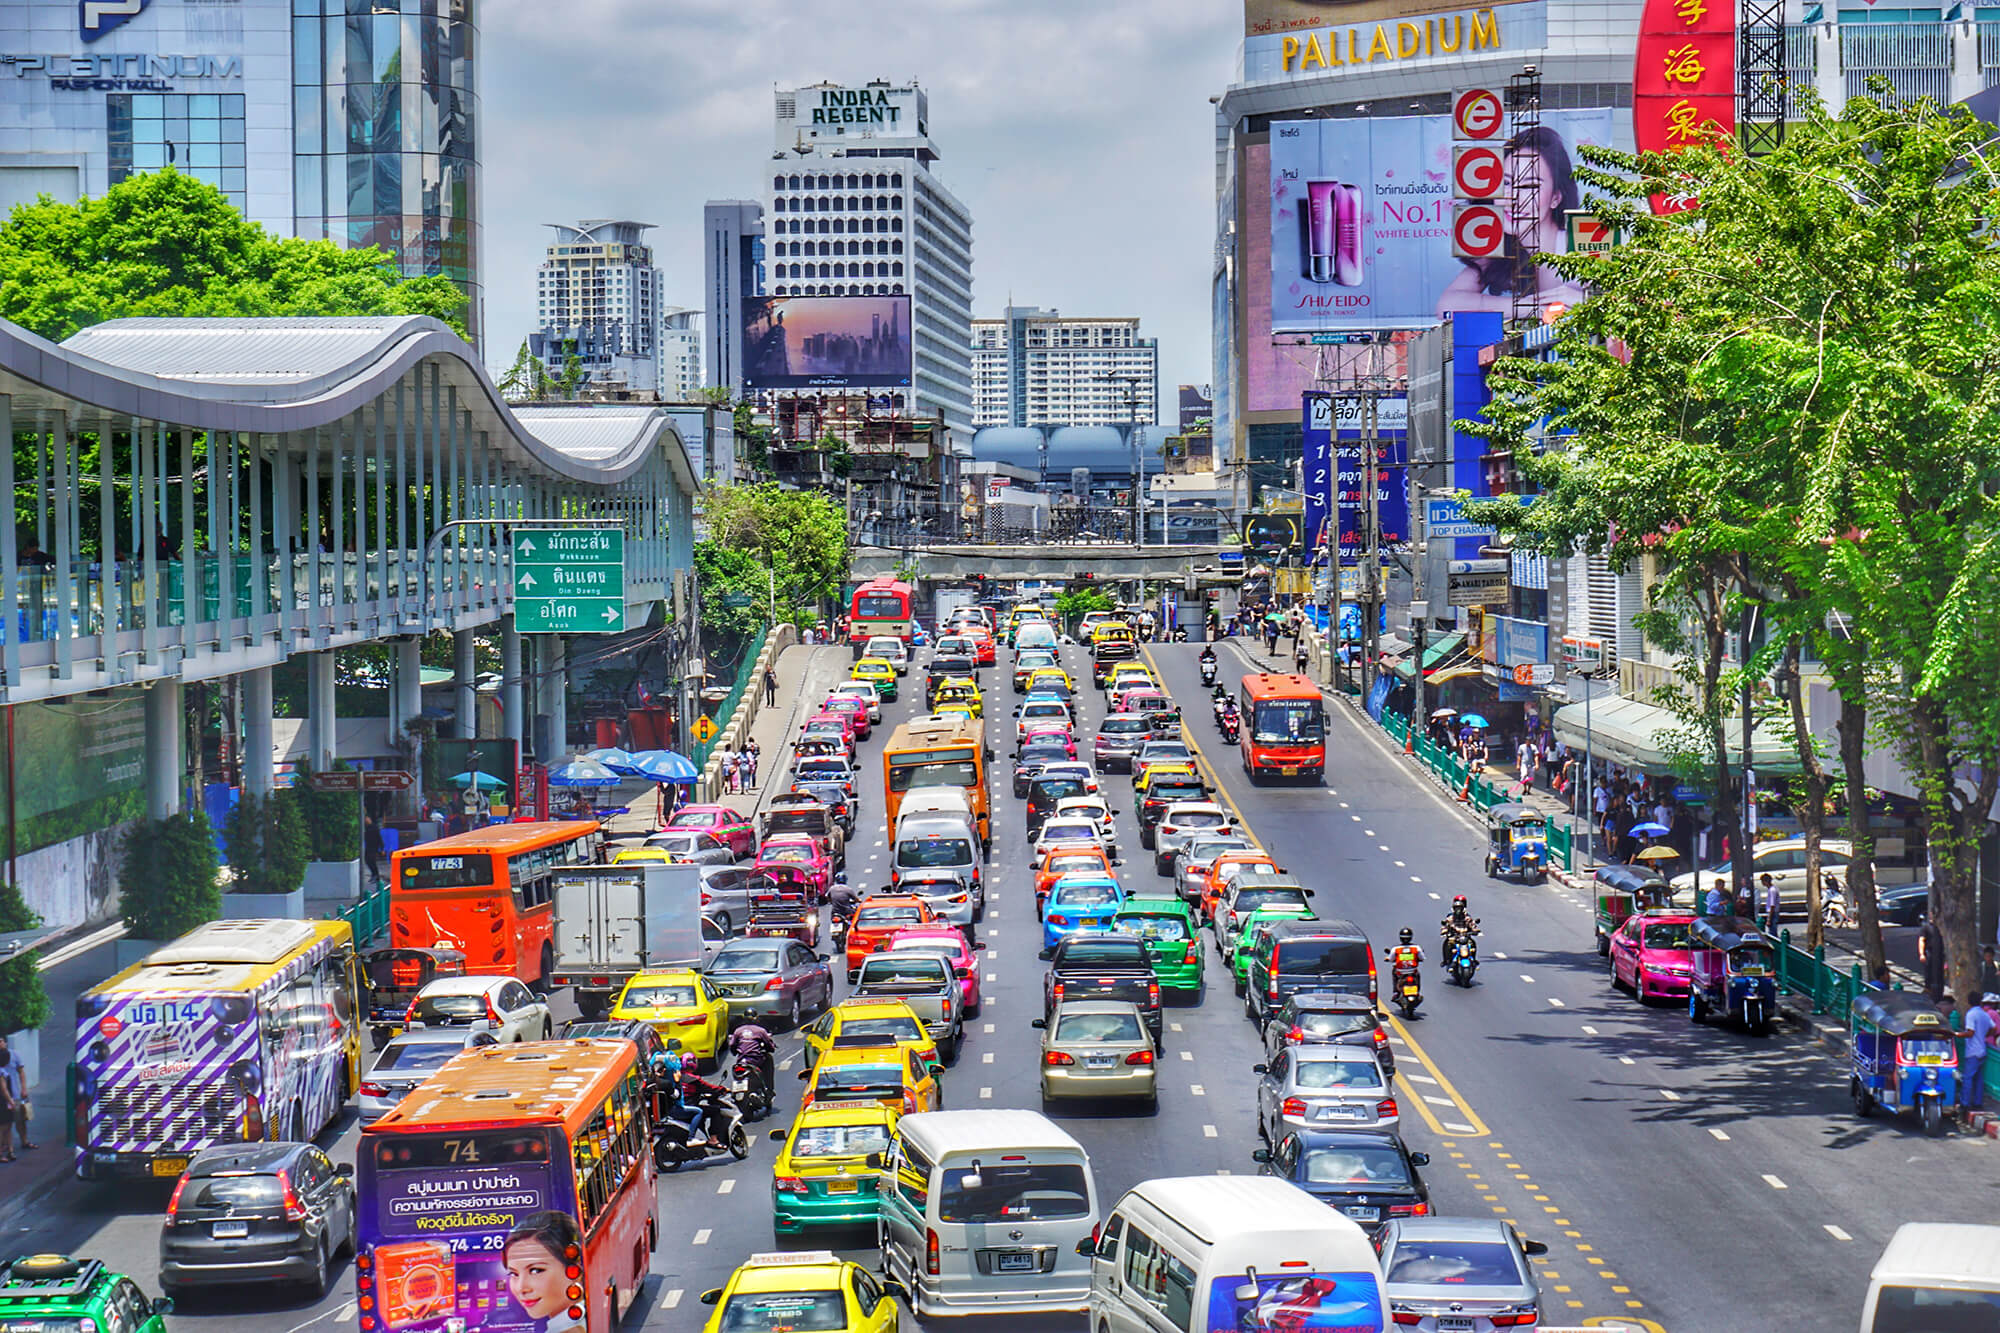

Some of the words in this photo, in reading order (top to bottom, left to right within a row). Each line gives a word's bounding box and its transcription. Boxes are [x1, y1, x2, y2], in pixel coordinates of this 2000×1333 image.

[1282, 8, 1500, 71] PALLADIUM
[51, 80, 123, 91] FASHION
[127, 80, 174, 91] MALL
[822, 90, 889, 107] INDRA
[812, 107, 900, 123] REGENT
[1374, 229, 1411, 240] WHITE
[1579, 222, 1609, 242] 7
[1294, 294, 1371, 309] SHISEIDO
[1316, 444, 1325, 459] 1
[1314, 469, 1326, 484] 2
[1313, 492, 1325, 507] 3
[1193, 519, 1218, 527] SPORT
[1433, 527, 1451, 535] TOP
[548, 532, 609, 550] มักกะสัน
[553, 567, 606, 584] ดินแดง
[540, 600, 577, 618] อโศก
[432, 858, 463, 870] 77-3
[170, 1003, 198, 1022] 14
[443, 1140, 479, 1163] 74
[472, 1174, 520, 1190] ปาปาย่า
[394, 1193, 534, 1213] ความมหัศจรรย์จากมะละกอ
[416, 1211, 515, 1231] ผิวดูดีขึ้นได้จริงๆ
[450, 1238, 469, 1252] 74
[483, 1236, 504, 1250] 26
